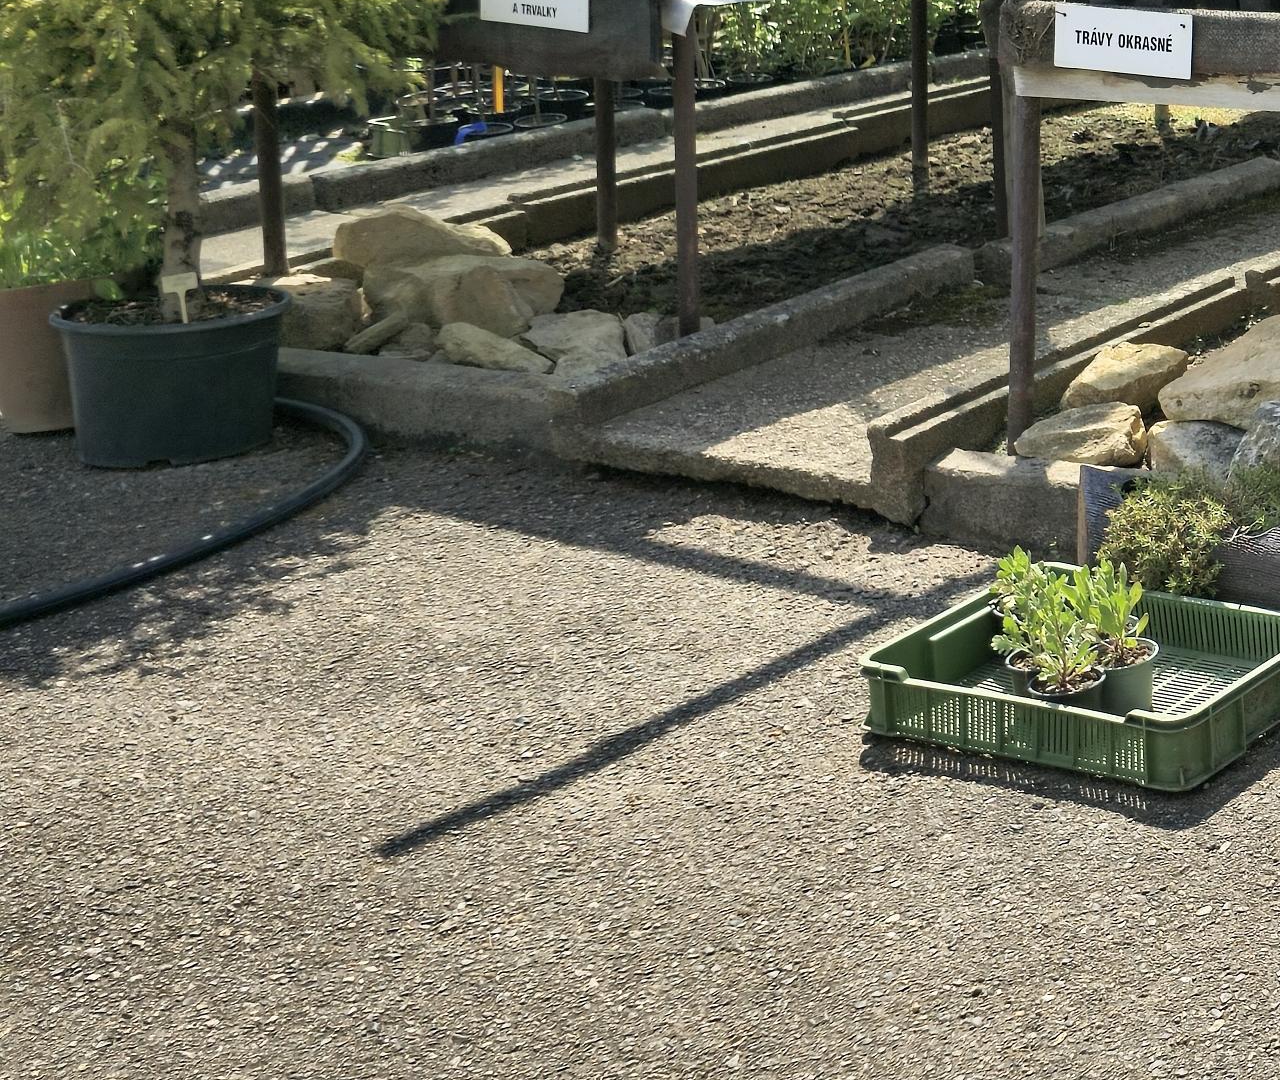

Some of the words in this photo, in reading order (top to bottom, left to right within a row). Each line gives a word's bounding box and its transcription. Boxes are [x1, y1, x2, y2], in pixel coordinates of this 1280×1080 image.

[512, 3, 518, 14] A
[521, 3, 557, 18] TRVALKY
[1075, 27, 1113, 47] TRÁVY
[1118, 34, 1172, 53] OKRASNÉ
